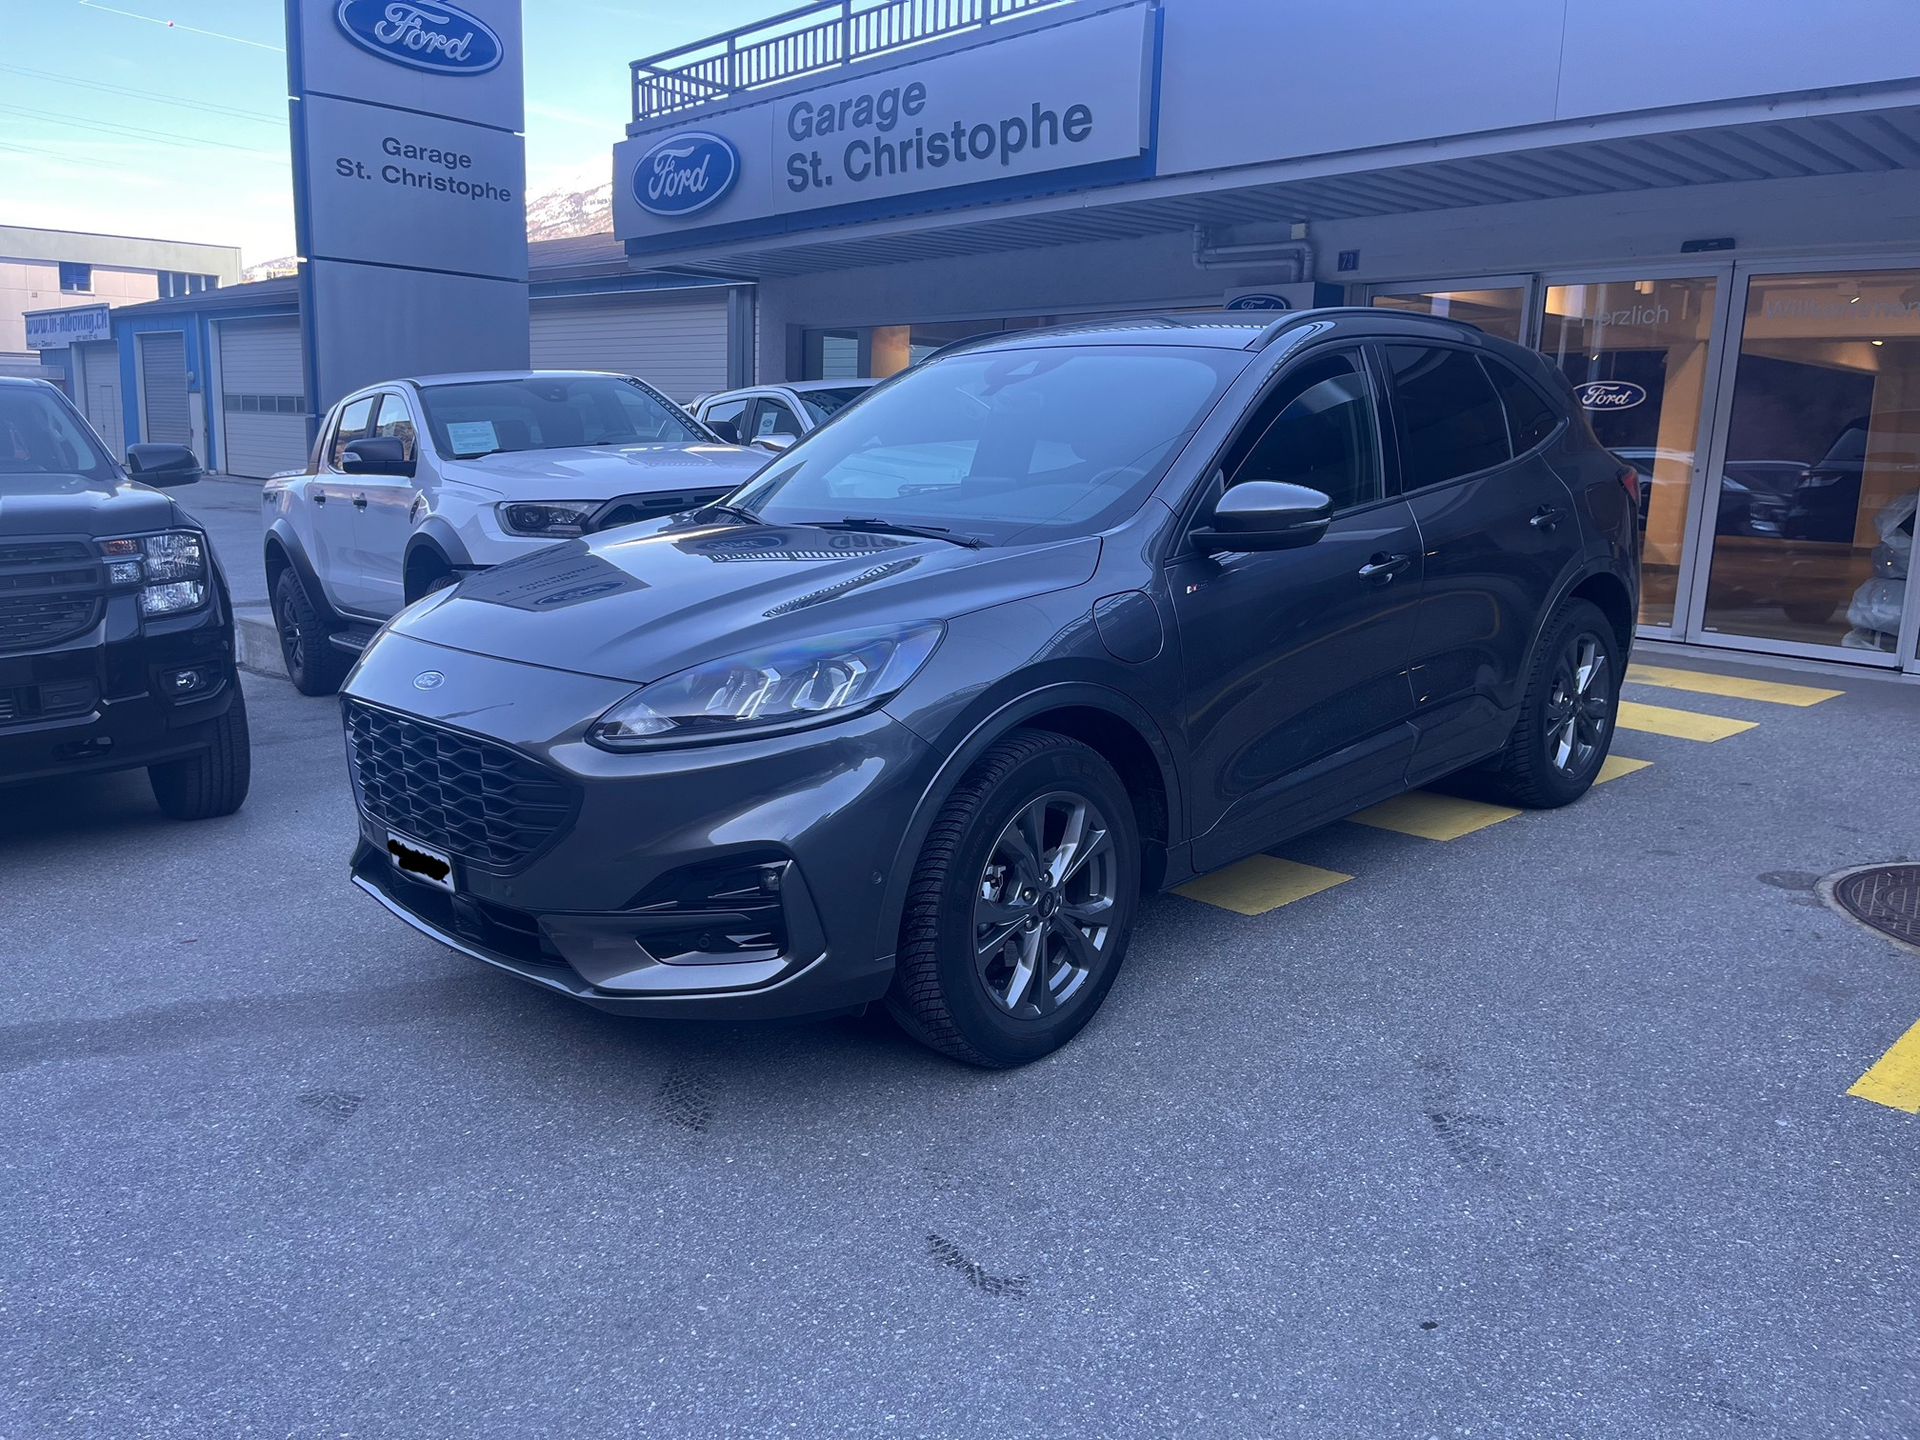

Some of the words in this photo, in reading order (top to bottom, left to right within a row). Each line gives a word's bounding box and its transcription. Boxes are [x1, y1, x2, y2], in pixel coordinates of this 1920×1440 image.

[375, 3, 473, 61] Ford
[787, 81, 926, 141] Garage
[382, 137, 472, 169] Garage
[787, 151, 833, 192] St.
[844, 102, 1093, 182] Christophe
[336, 158, 372, 180] St.
[381, 165, 511, 202] Christophe
[649, 145, 711, 200] Ford
[1341, 253, 1354, 269] 73
[1582, 385, 1632, 404] Ford
